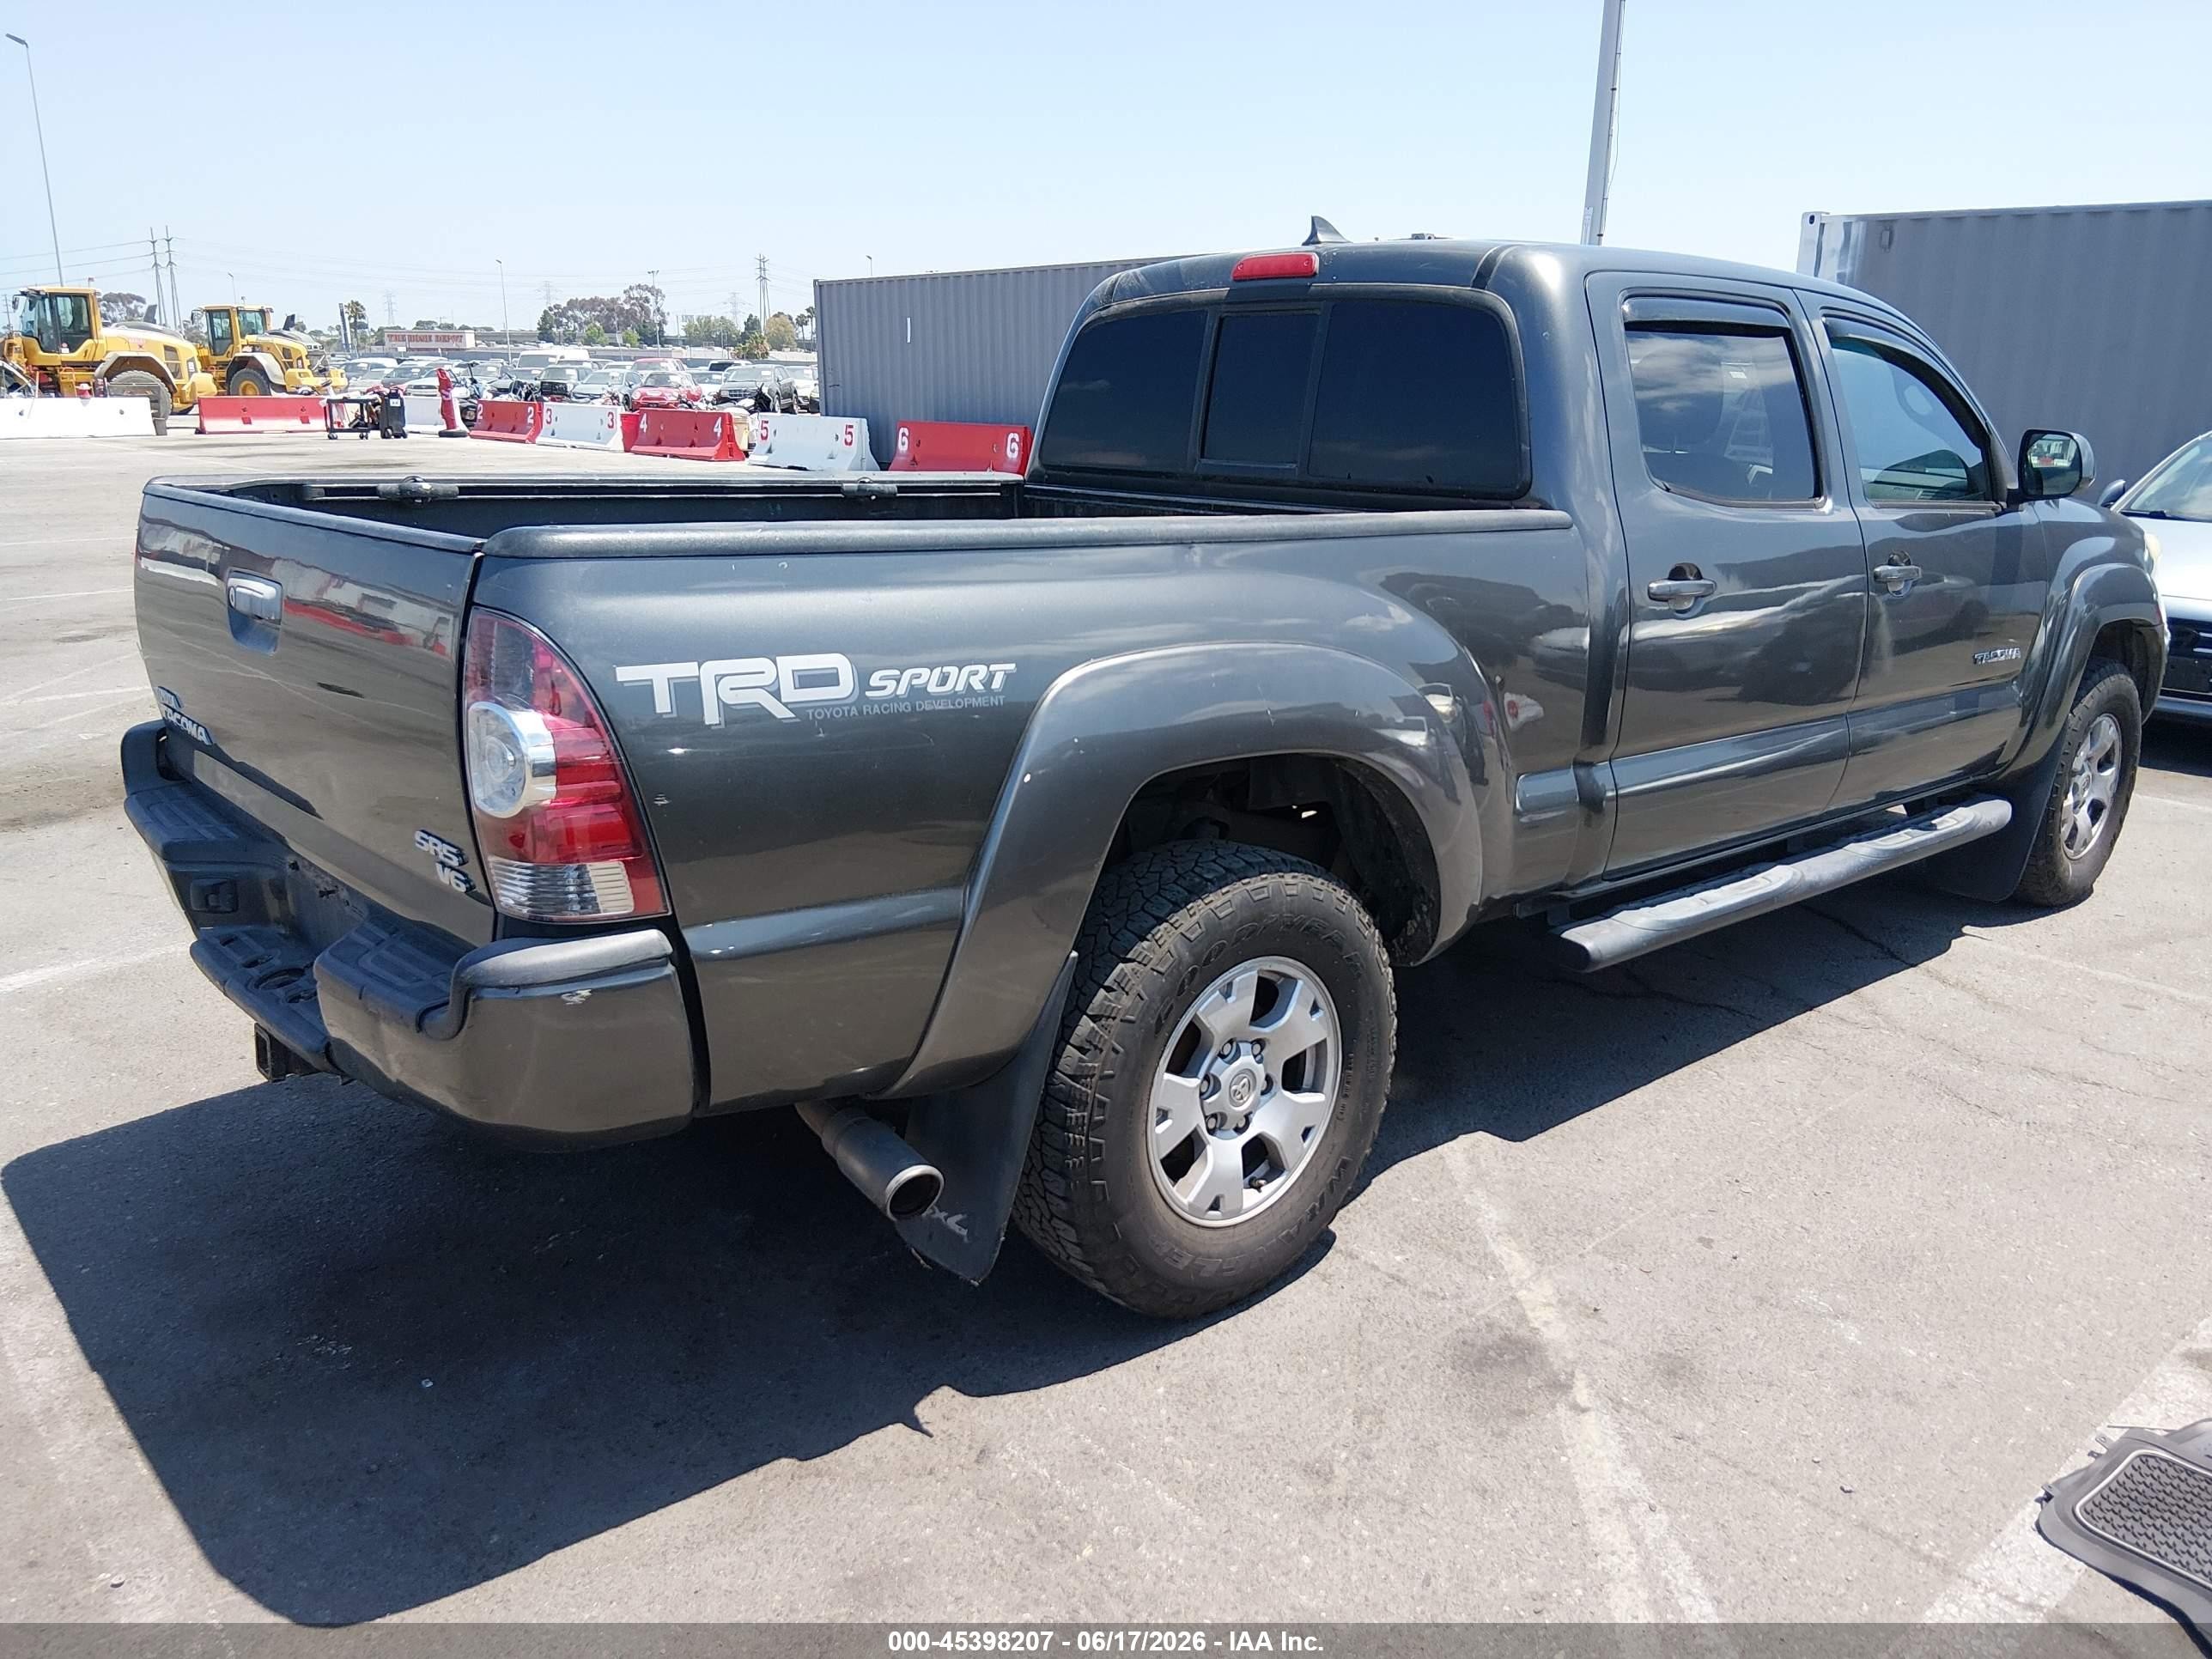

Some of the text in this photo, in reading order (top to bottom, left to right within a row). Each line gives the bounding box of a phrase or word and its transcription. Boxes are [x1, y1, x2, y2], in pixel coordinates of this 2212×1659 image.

[477, 404, 483, 420] 2
[527, 406, 534, 424] 2
[545, 408, 552, 425] 3
[607, 411, 615, 428] 3
[639, 413, 647, 433] 4
[713, 416, 722, 437] 4
[760, 420, 769, 441] 5
[844, 424, 854, 447] 5
[897, 427, 909, 452] 6
[1006, 432, 1019, 459] 6
[615, 653, 1018, 728] TRD SPORT
[805, 696, 1006, 720] TOYOTA RACING DEVELOPMENT
[415, 830, 463, 866] SR5
[435, 863, 471, 892] V6
